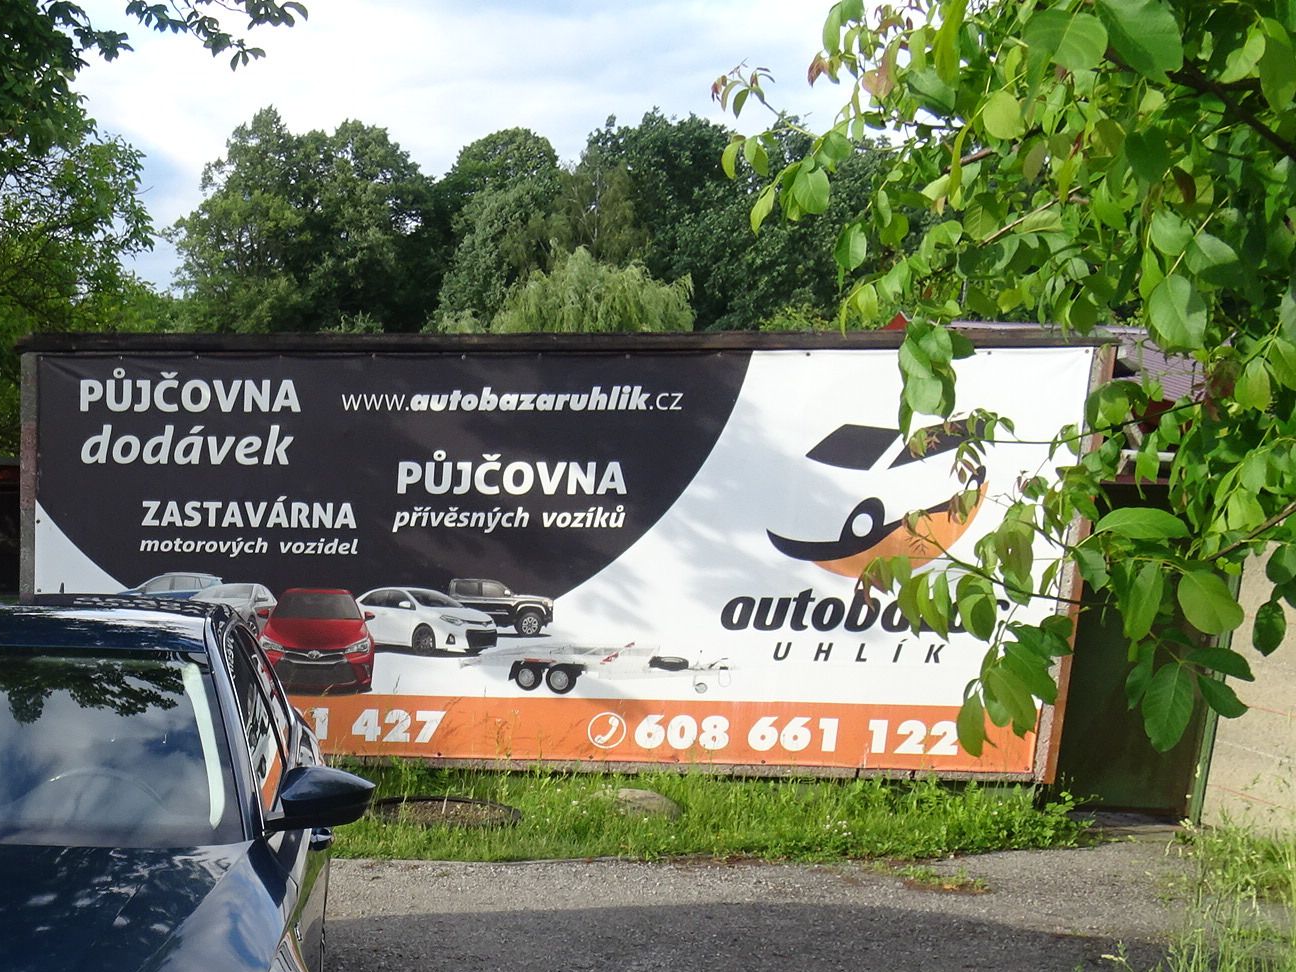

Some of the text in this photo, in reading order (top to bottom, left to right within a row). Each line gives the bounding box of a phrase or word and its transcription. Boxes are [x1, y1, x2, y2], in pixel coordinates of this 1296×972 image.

[79, 367, 301, 413] PŮJČOVNA
[341, 386, 684, 412] www.autobazaruhlik.cz
[80, 423, 294, 466] dodávek
[396, 449, 628, 496] PŮJČOVNA
[141, 496, 357, 530] ZASTAVÁRNA
[392, 504, 627, 533] přívěsných vozíků
[139, 536, 359, 556] motorových vozidel
[773, 638, 946, 663] UHLÍK
[351, 708, 447, 744] 427
[634, 713, 959, 756] 608 661 122
